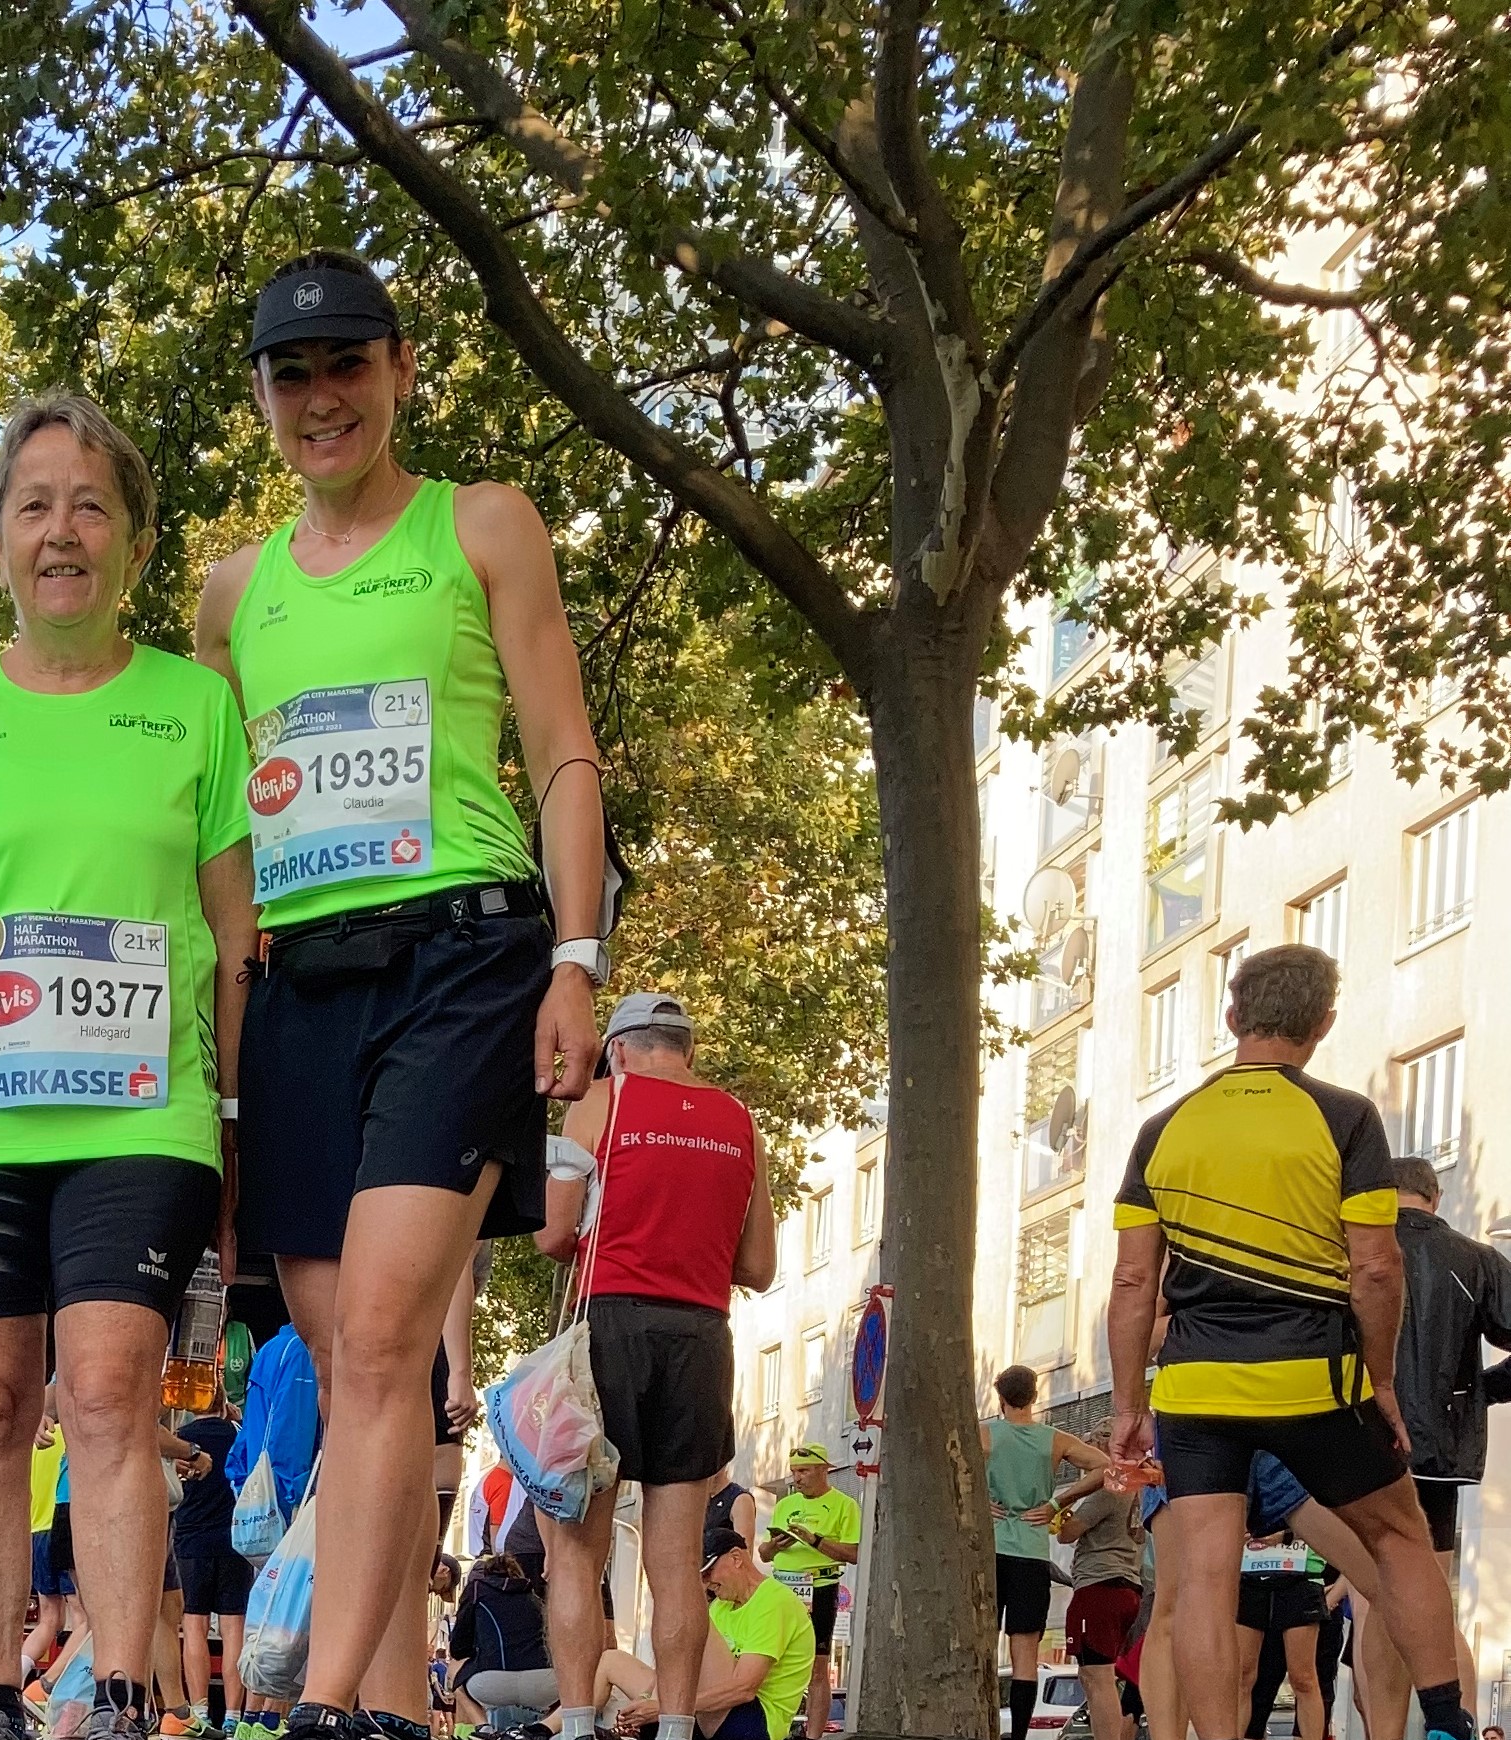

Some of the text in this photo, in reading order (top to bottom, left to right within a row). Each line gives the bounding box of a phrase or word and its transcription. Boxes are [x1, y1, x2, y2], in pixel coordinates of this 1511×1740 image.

[109, 718, 173, 733] LAUF-TREFF
[308, 745, 425, 794] 19335
[251, 769, 297, 804] Hervis
[343, 797, 384, 810] Claudia
[260, 840, 386, 893] SPARKASSE
[28, 915, 54, 923] VIENNA
[54, 916, 69, 924] CITY
[69, 917, 106, 927] MARATHON
[13, 924, 43, 936] HALF
[13, 935, 78, 947] MARATHON
[48, 976, 163, 1019] 19377
[80, 1025, 131, 1040] Hildegard
[620, 1131, 742, 1158] EK Schwaikheim
[138, 1262, 170, 1280] erima
[1251, 1560, 1281, 1570] ERSTE
